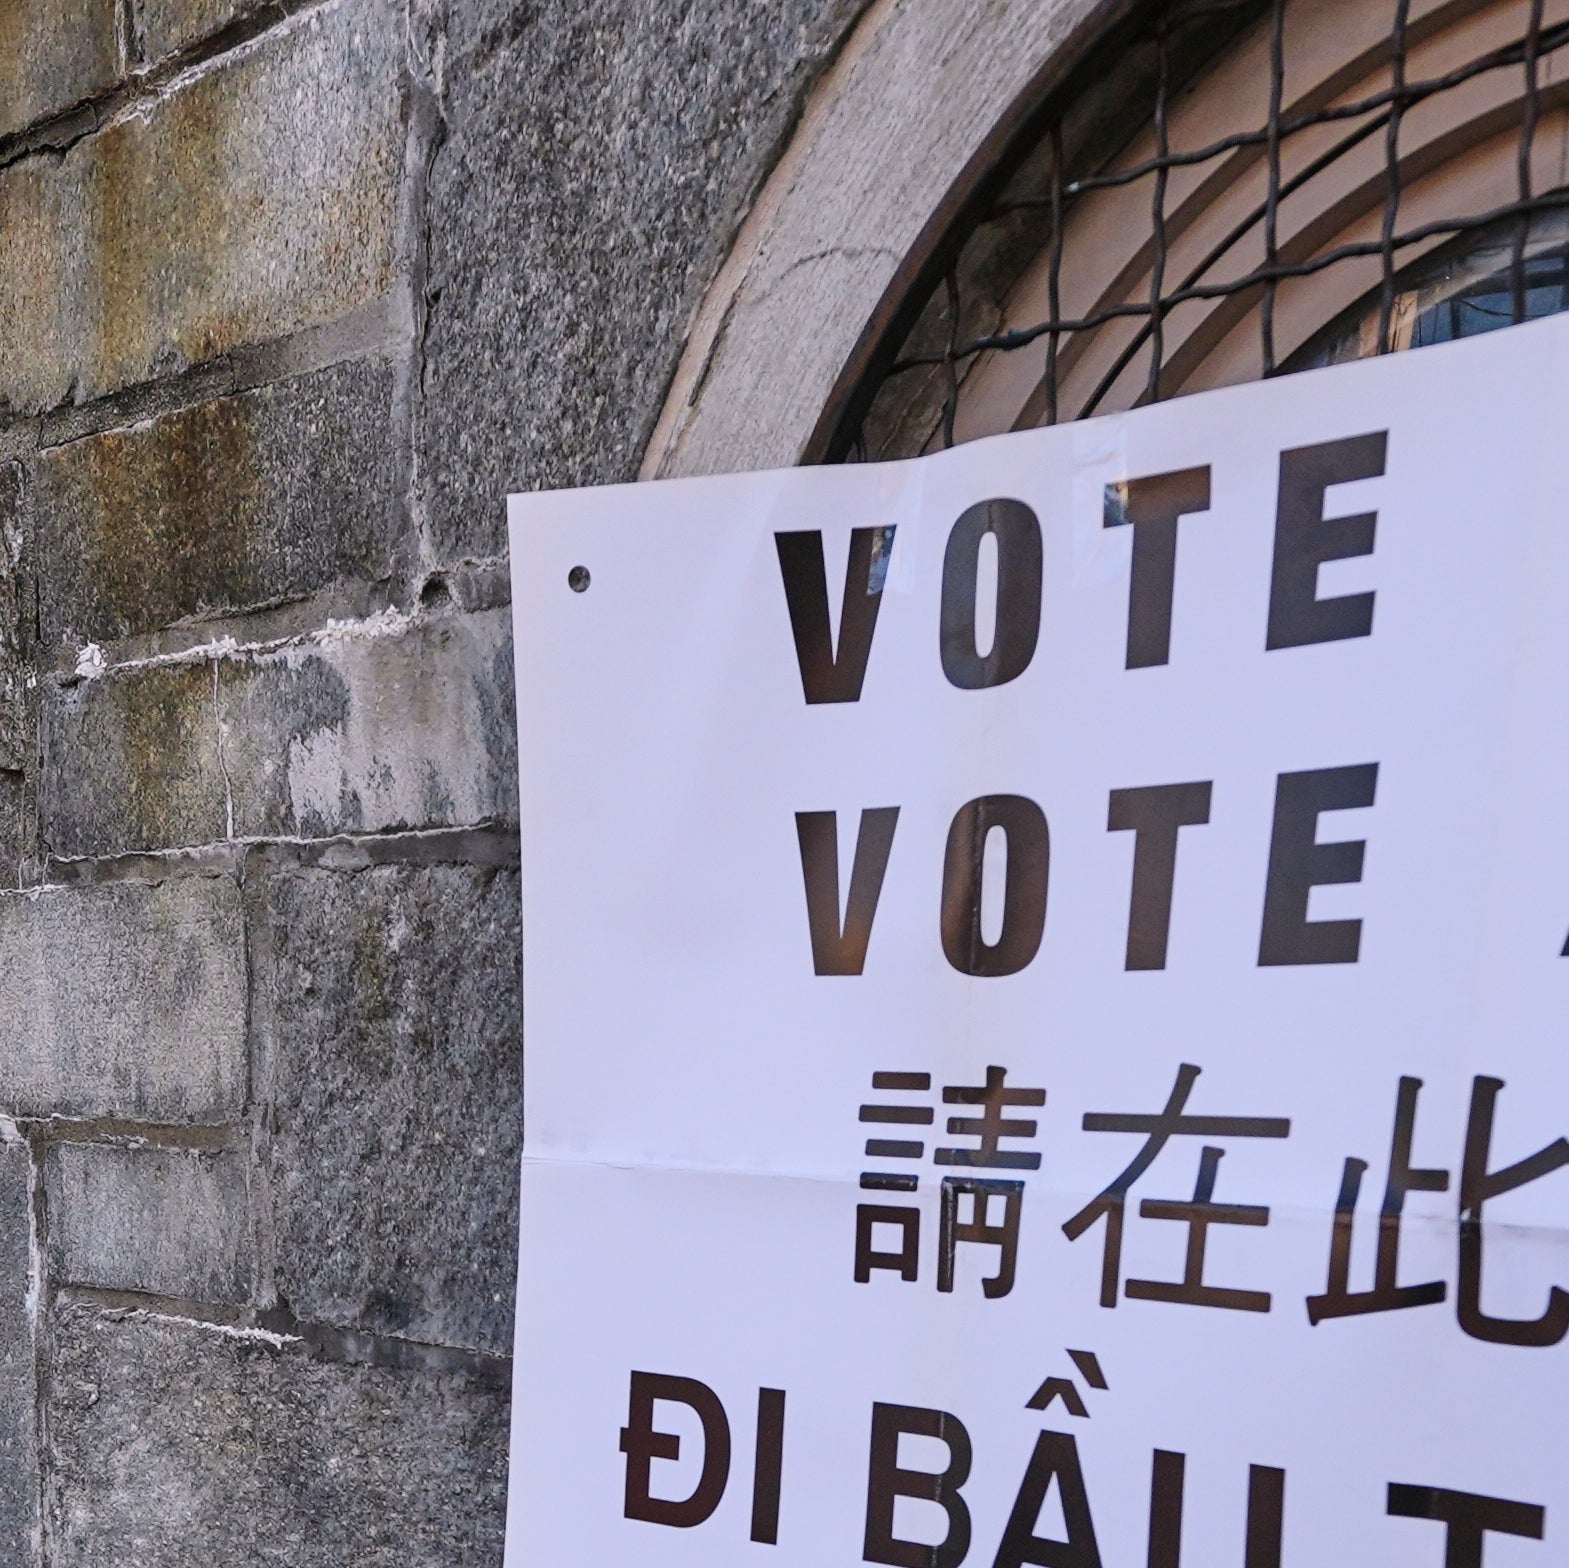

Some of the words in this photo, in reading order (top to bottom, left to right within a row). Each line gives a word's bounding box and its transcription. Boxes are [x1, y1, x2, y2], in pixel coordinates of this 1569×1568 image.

[772, 430, 1389, 706] VOTE
[793, 761, 1380, 978] VOTE
[618, 1369, 787, 1546] ĐI
